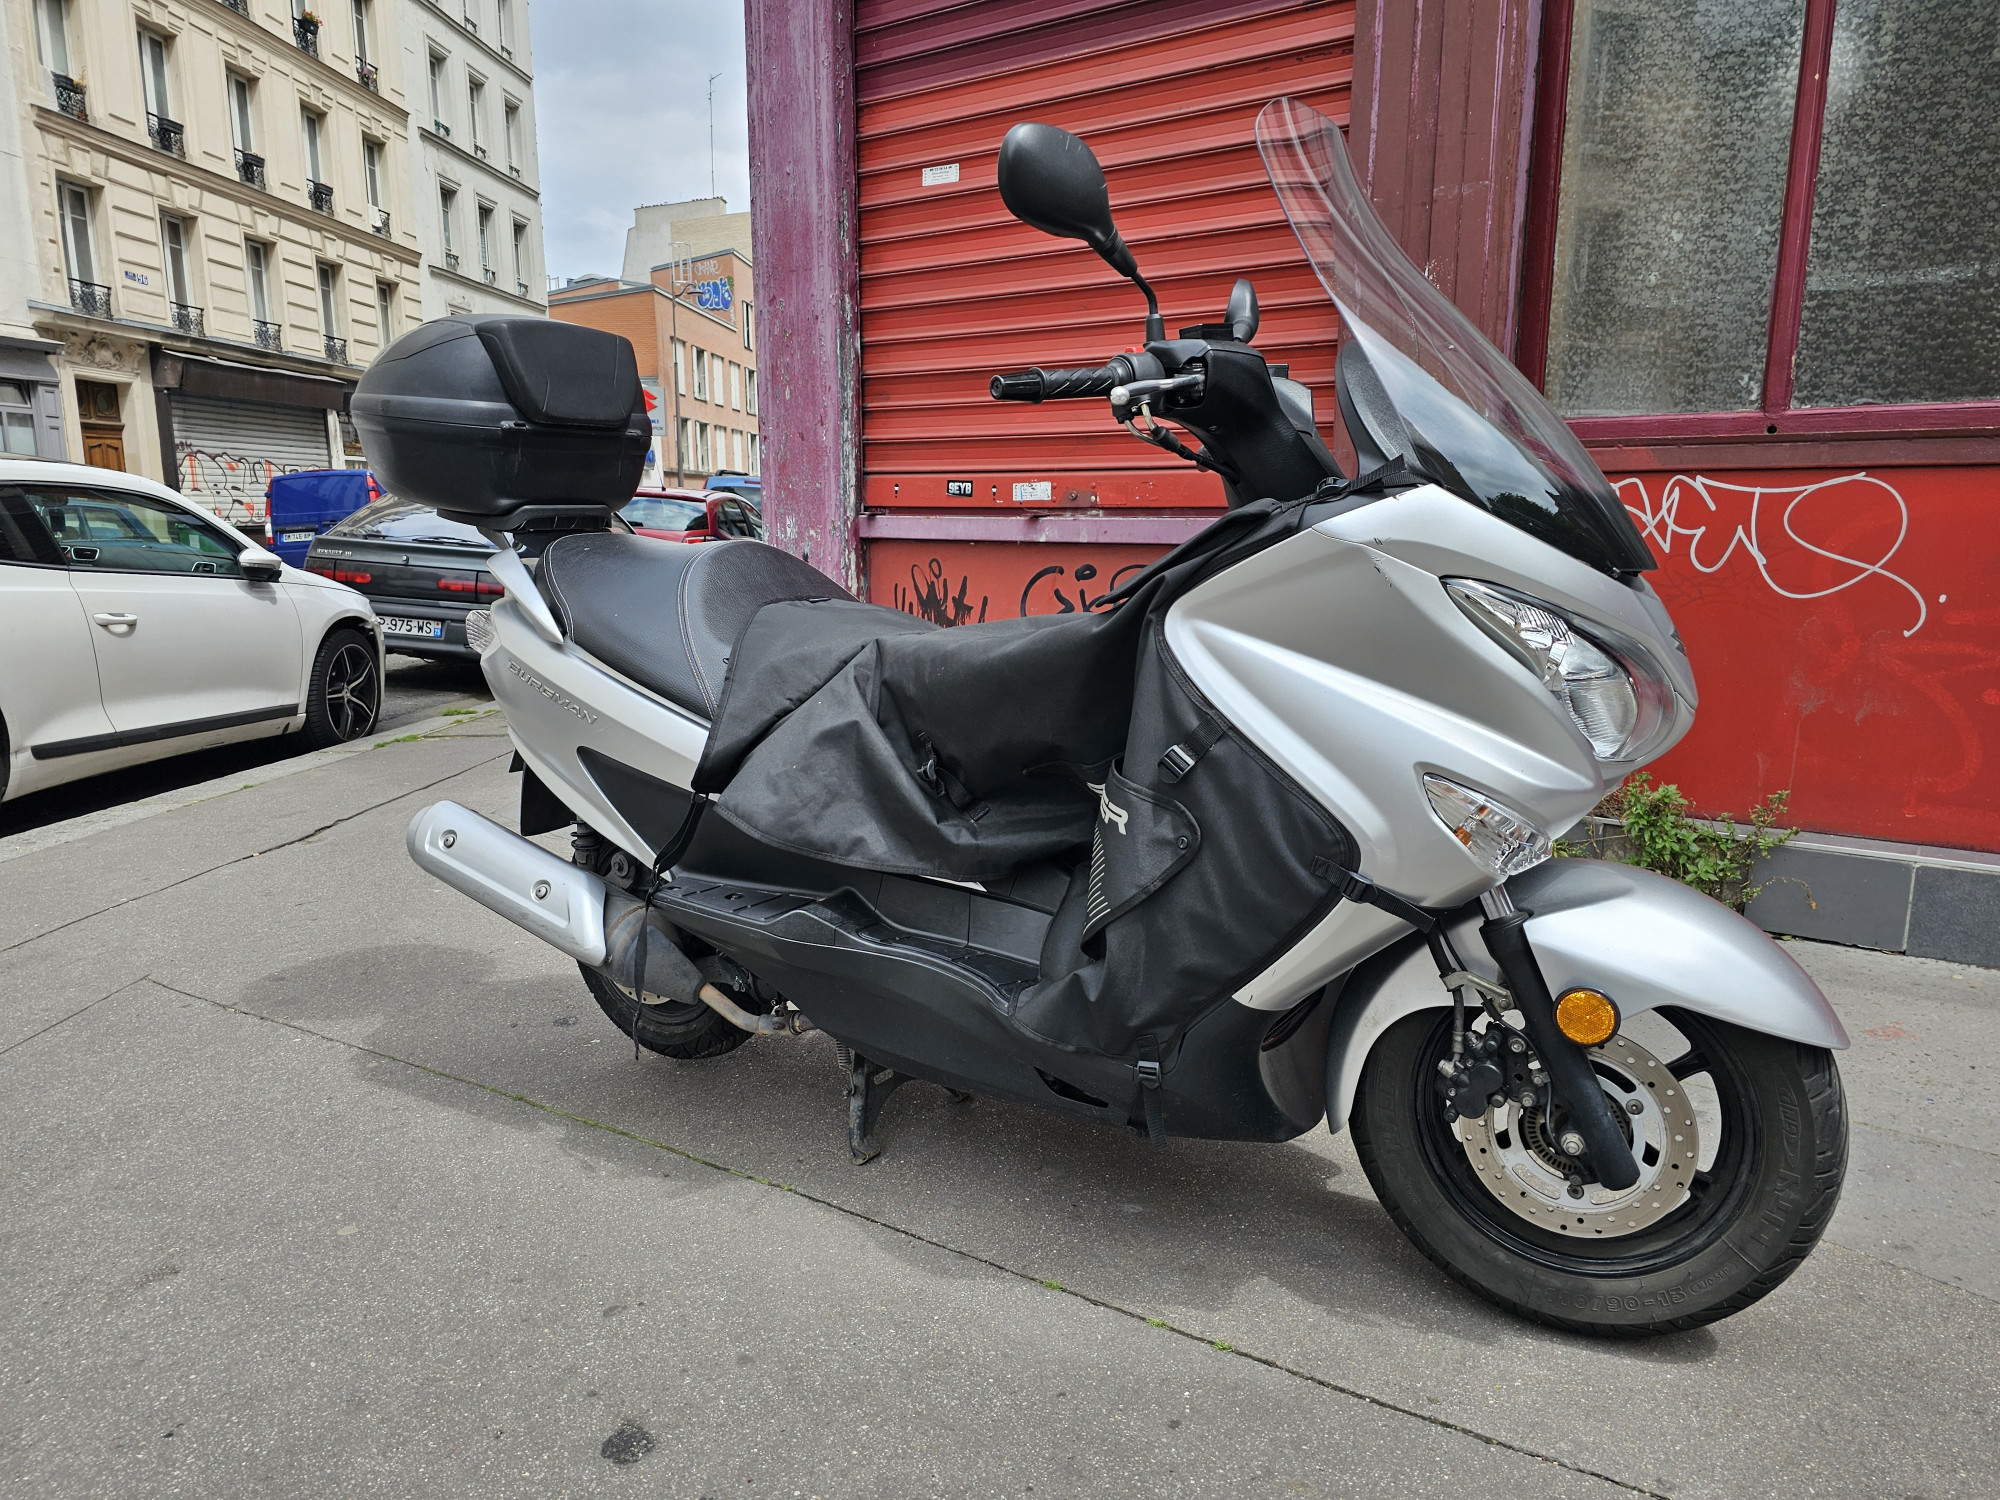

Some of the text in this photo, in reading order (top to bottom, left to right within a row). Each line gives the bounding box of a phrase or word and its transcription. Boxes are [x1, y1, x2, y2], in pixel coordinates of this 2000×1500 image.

[137, 274, 148, 285] 96
[948, 482, 972, 494] SEYB
[508, 659, 598, 725] BURGMAN
